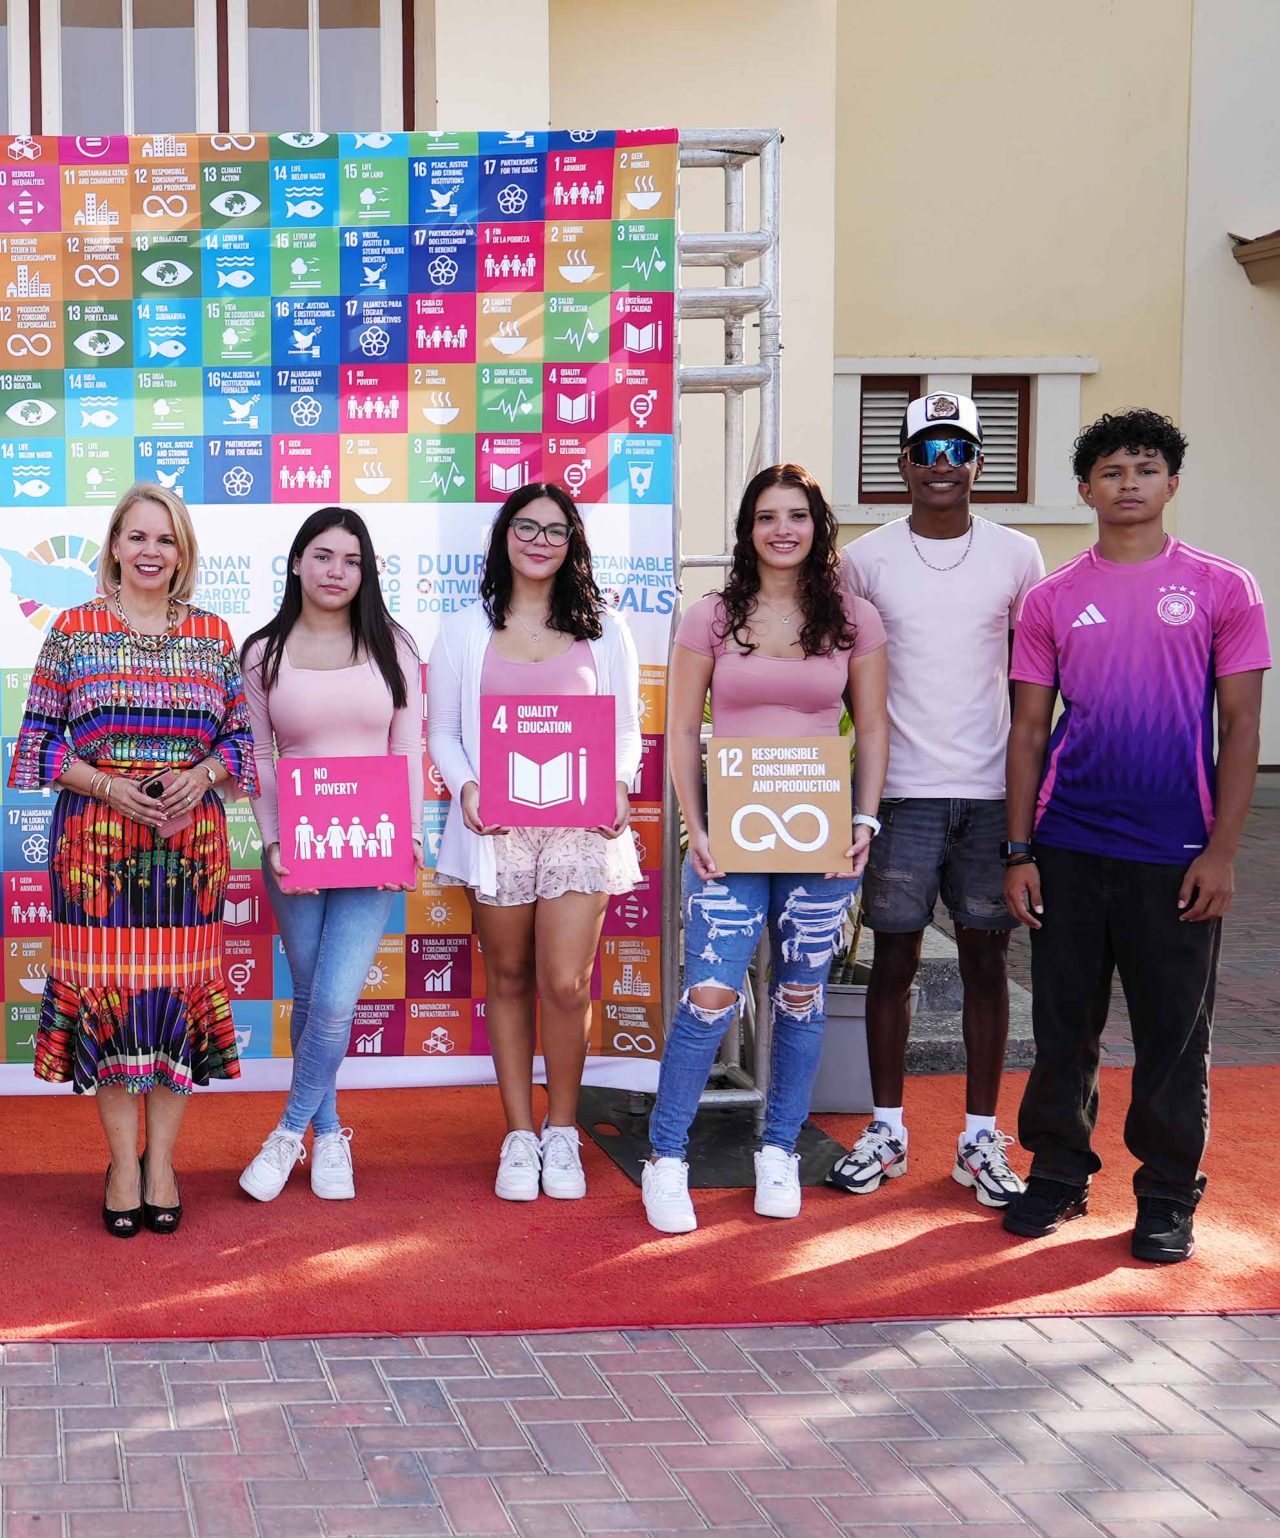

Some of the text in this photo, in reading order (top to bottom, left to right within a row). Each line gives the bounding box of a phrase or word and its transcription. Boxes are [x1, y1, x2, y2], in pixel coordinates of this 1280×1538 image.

[413, 162, 427, 177] 16
[484, 160, 495, 174] 17
[521, 165, 538, 173] GOALS
[555, 157, 560, 171] 1
[203, 167, 217, 182] 13
[274, 166, 287, 180] 14
[344, 164, 357, 179] 15
[485, 228, 490, 243] 1
[276, 302, 289, 316] 16
[416, 299, 421, 314] 1
[616, 297, 624, 312] 4
[68, 306, 81, 320] 13
[0, 375, 13, 390] 13
[347, 370, 352, 384] 1
[198, 556, 250, 569] ANAN
[592, 556, 672, 571] STAINABLE
[194, 588, 250, 600] SAROYO
[518, 706, 558, 718] QUALITY
[492, 706, 508, 733] 4
[518, 720, 571, 733] EDUCATION
[752, 748, 818, 760] RESPONSIBLE
[718, 748, 743, 776] 12
[314, 768, 327, 780] NO
[752, 764, 825, 776] CONSUMPTION
[291, 769, 302, 796] 1
[315, 783, 358, 795] POVERTY
[752, 780, 840, 792] AND PRODUCTION
[411, 939, 419, 953] 8
